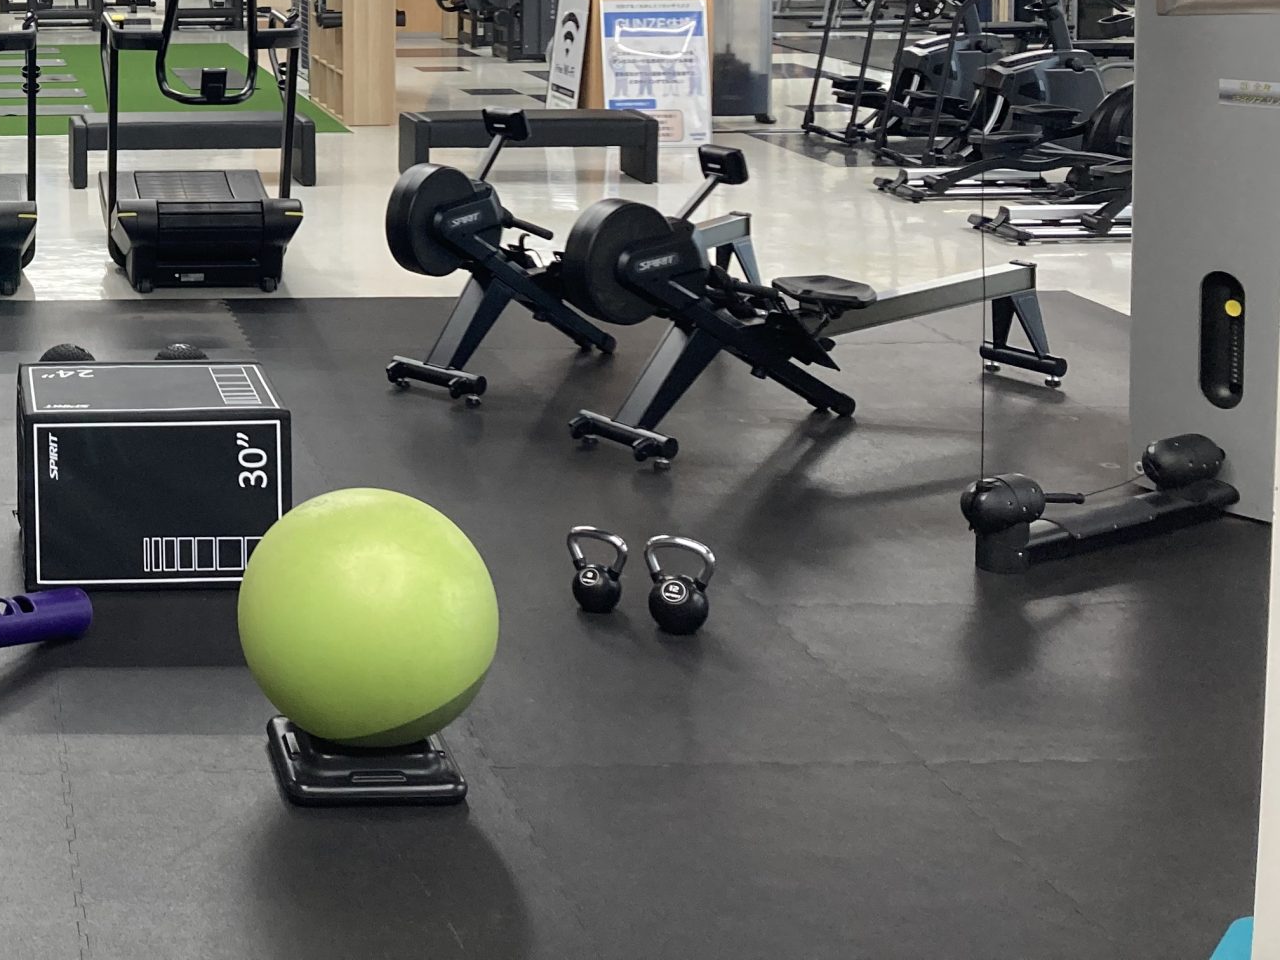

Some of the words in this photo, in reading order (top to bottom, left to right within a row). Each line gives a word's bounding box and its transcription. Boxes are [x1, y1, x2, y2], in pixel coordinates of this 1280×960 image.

[451, 212, 480, 227] SPIRIT
[639, 253, 677, 271] SPIRIT
[48, 432, 59, 480] SPIRIT
[669, 584, 680, 593] 12
